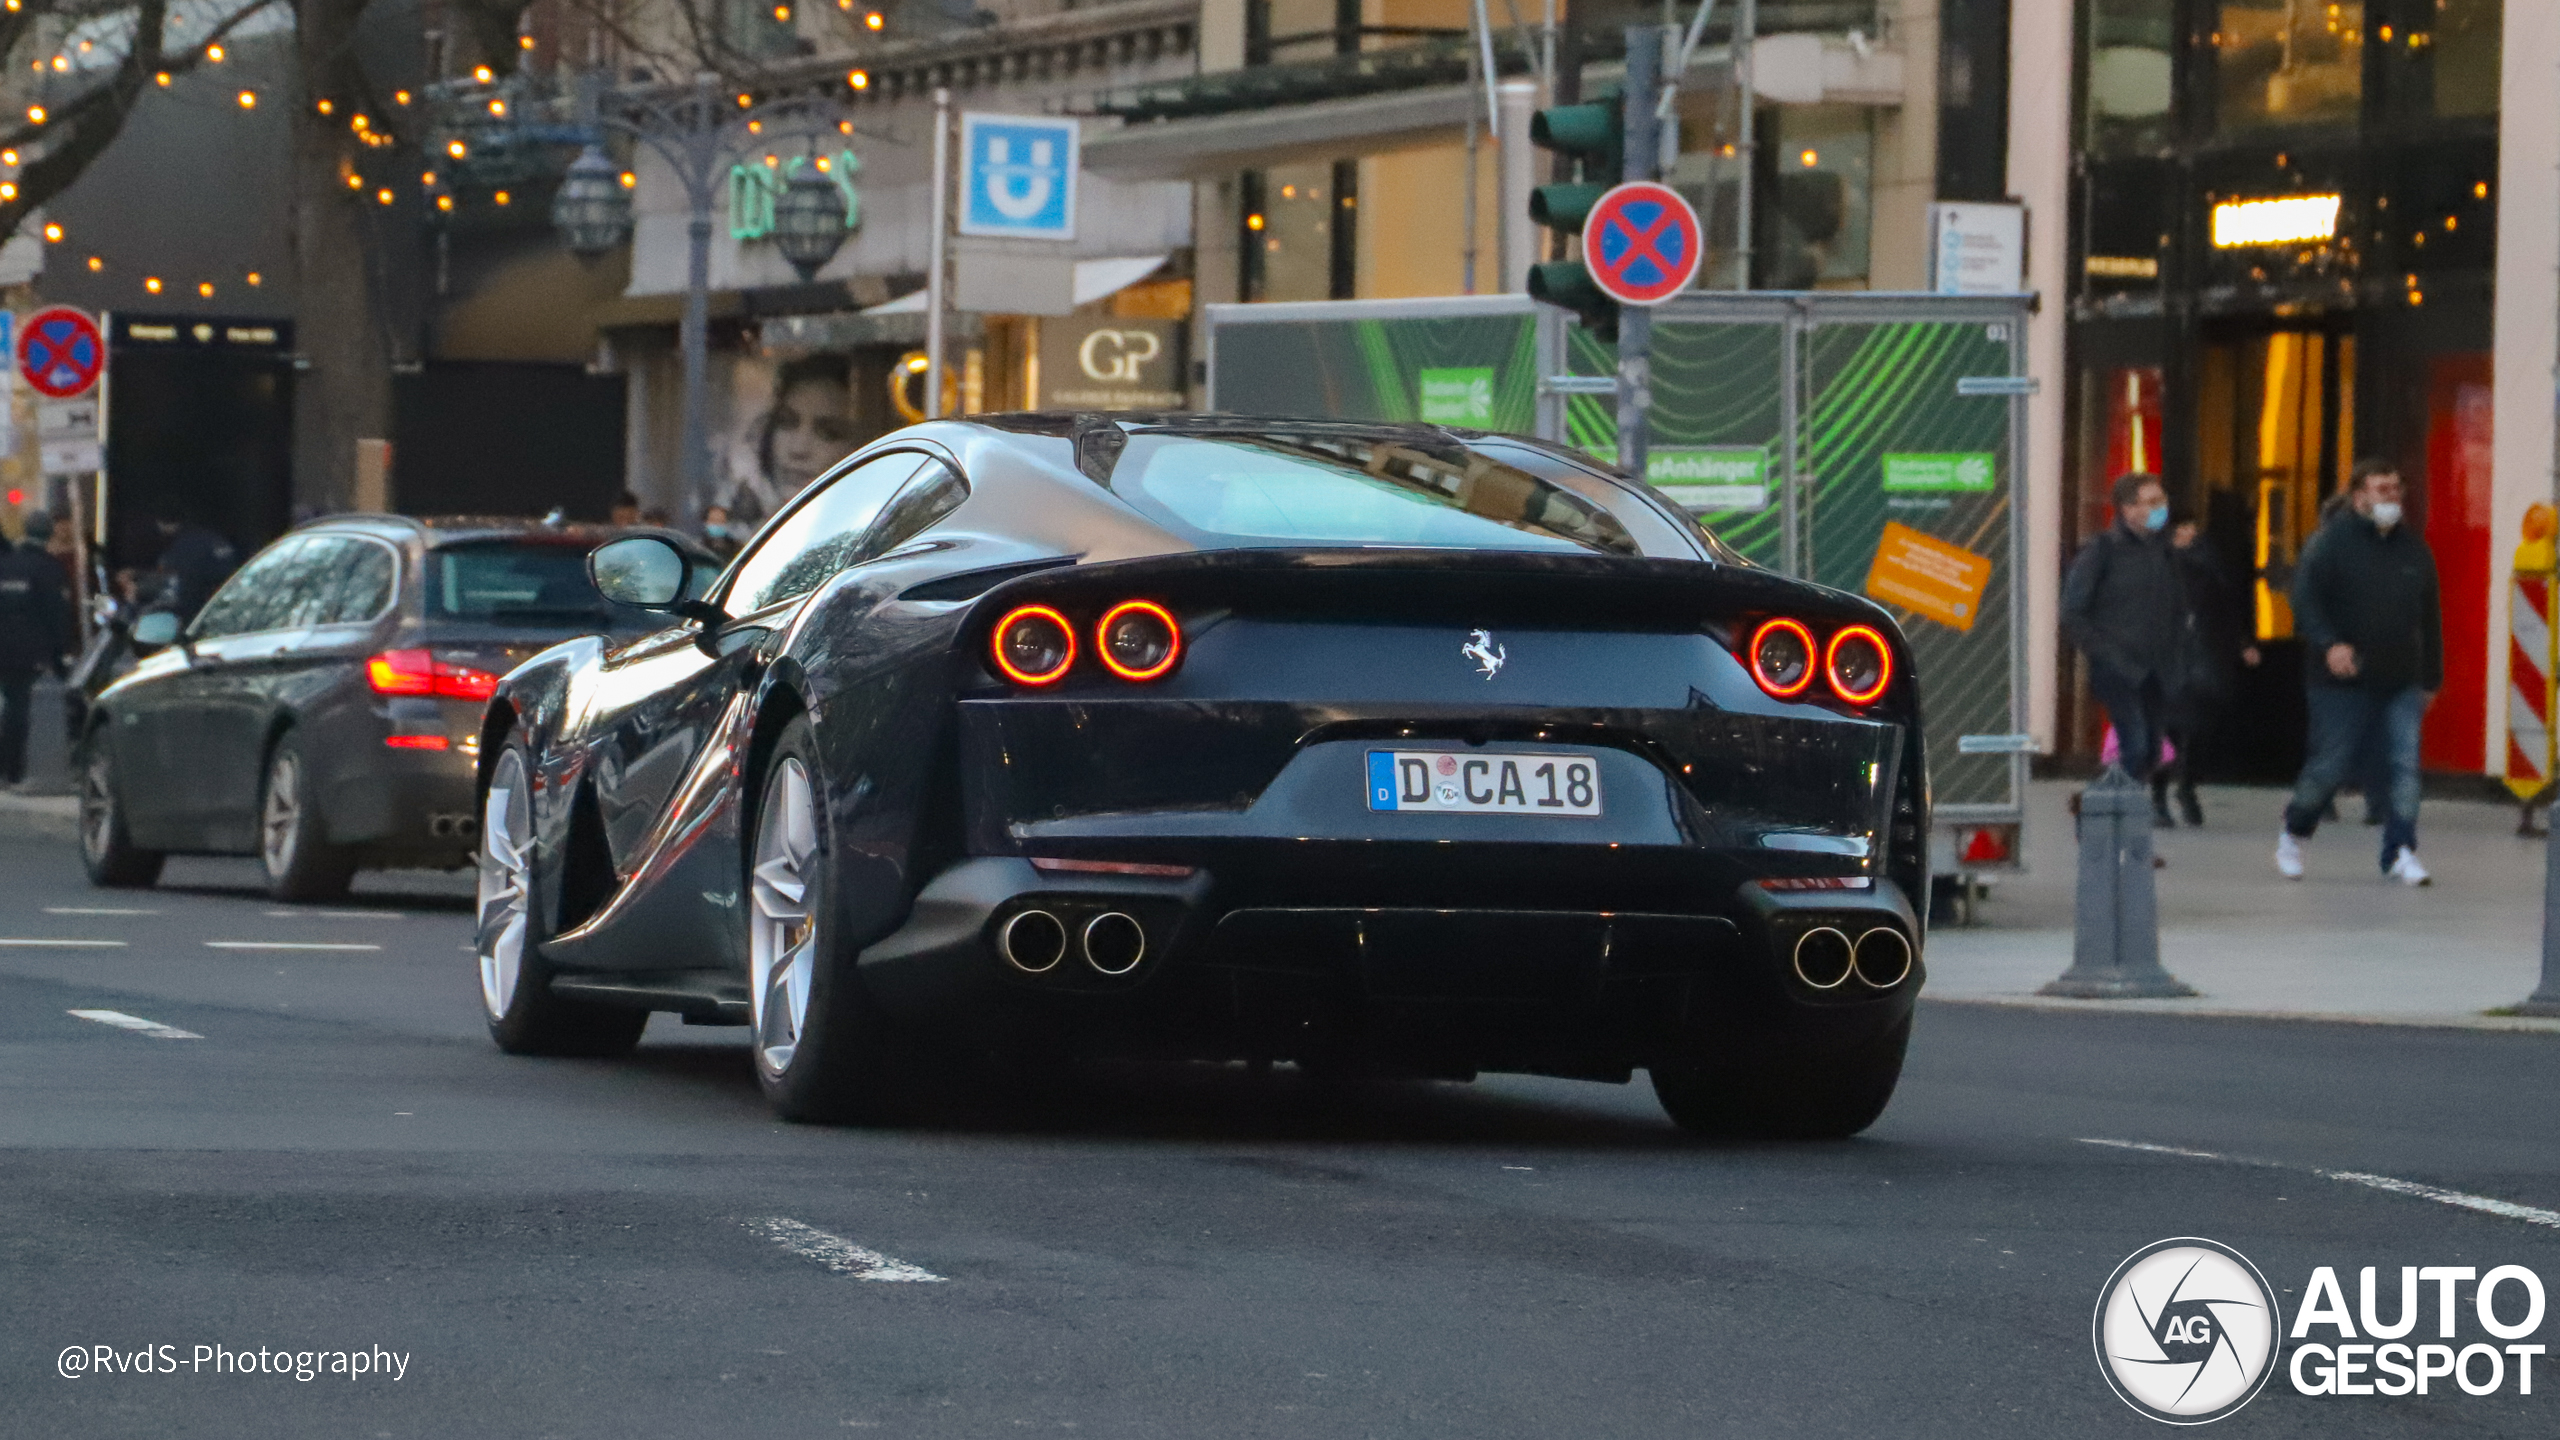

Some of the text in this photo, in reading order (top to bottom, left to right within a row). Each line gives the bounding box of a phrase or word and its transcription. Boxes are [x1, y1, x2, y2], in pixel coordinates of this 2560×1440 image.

[987, 136, 1052, 219] U
[1079, 328, 1160, 380] GP
[1378, 788, 1389, 801] D
[1399, 758, 1431, 803] D
